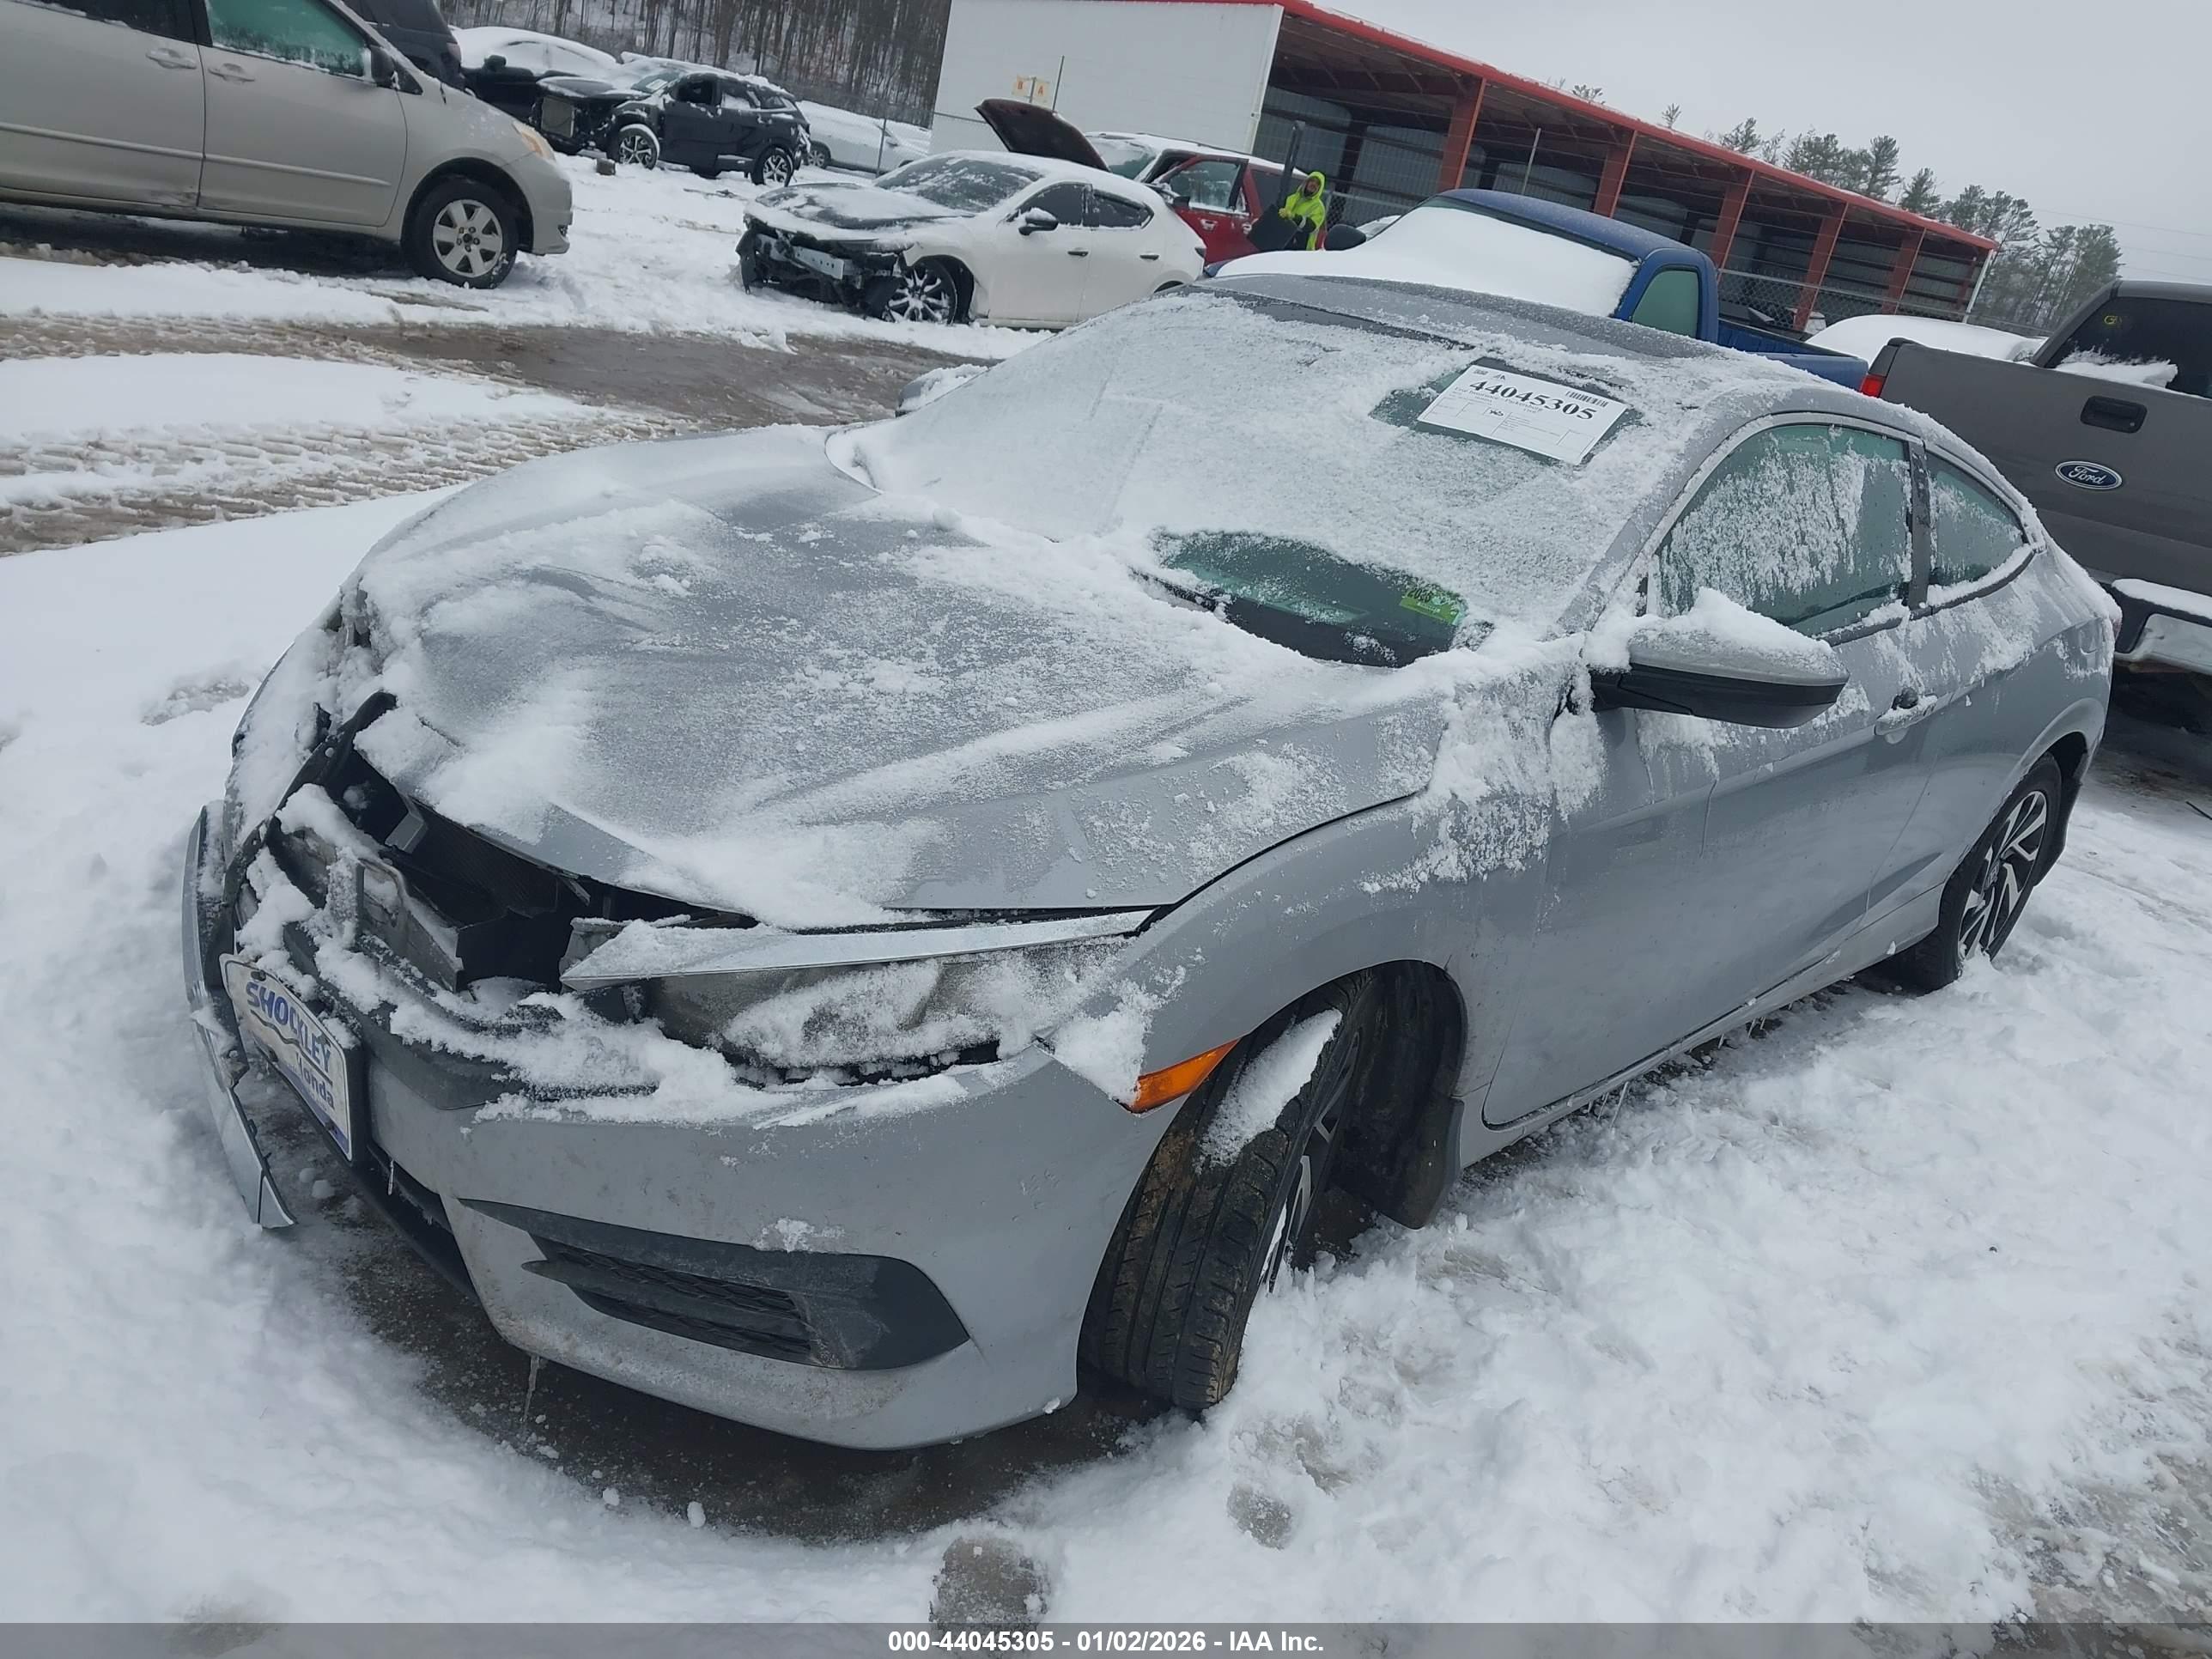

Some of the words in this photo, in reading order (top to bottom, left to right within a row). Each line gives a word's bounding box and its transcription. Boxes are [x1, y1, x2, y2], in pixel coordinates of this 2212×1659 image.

[1037, 85, 1045, 96] A
[1469, 380, 1597, 420] 44045305
[2068, 465, 2106, 484] Ford
[246, 981, 332, 1073] SHOCKLEY
